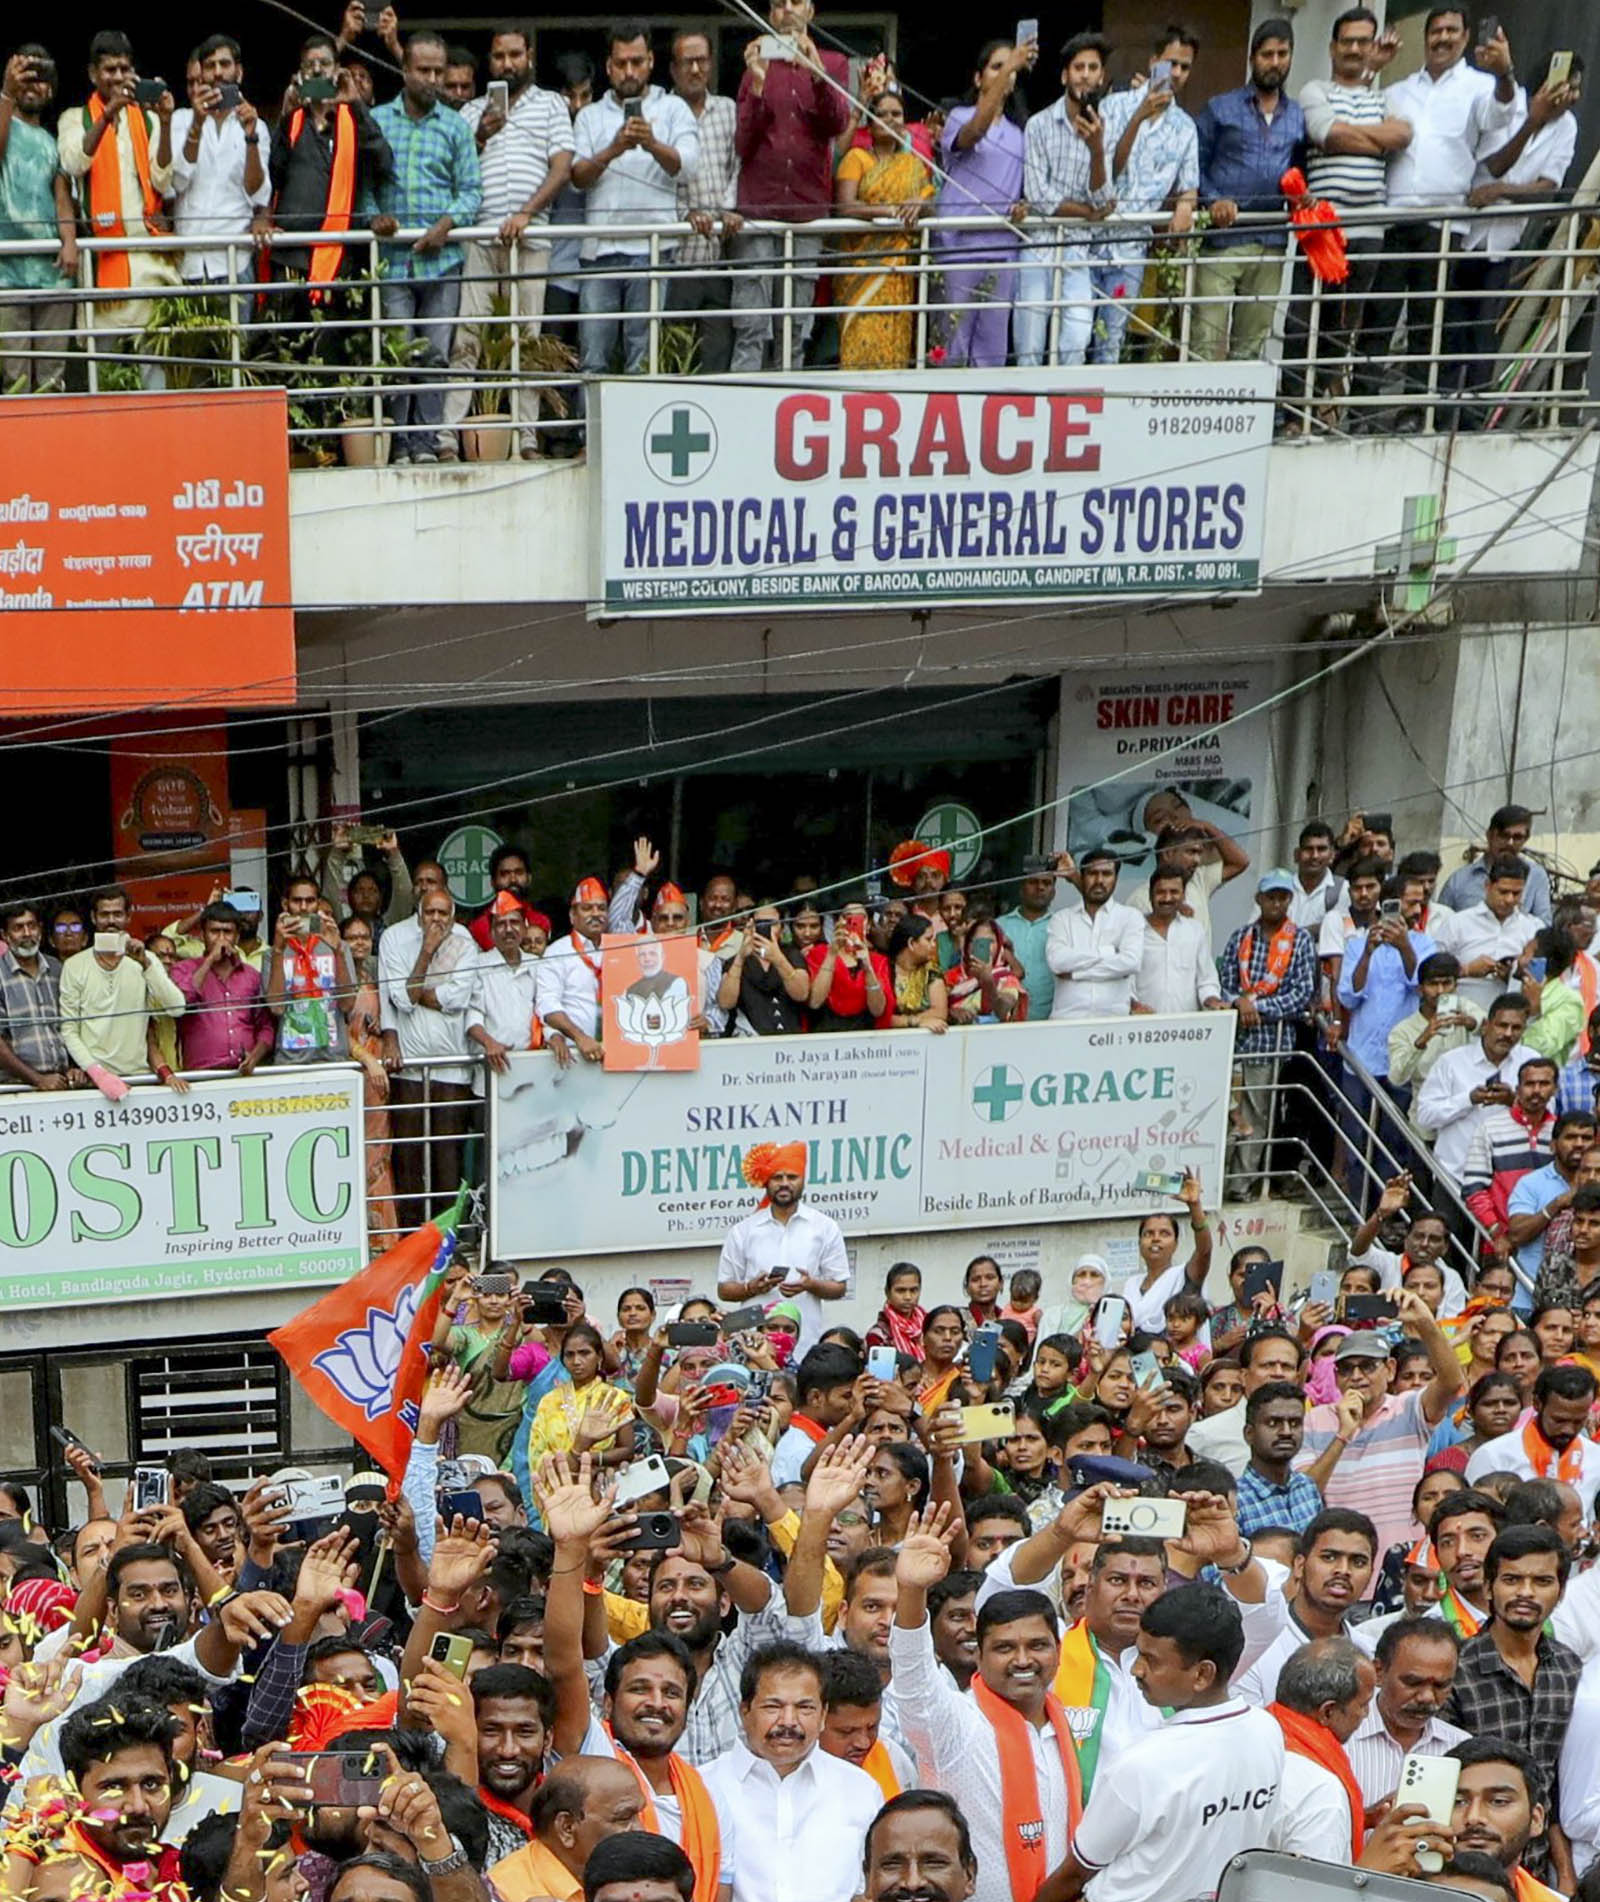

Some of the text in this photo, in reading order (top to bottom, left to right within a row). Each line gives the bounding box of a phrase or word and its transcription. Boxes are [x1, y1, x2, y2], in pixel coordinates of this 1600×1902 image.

[773, 386, 1105, 483] GRACE
[1147, 415, 1257, 436] 9182094087
[623, 483, 1247, 569] MEDICAL & GENERAL STORES
[176, 523, 264, 566] एटीएम
[178, 580, 265, 613] ATM
[622, 581, 689, 599] WESTEND
[690, 578, 749, 598] COLONY,
[751, 577, 800, 594] BESIDE
[802, 576, 841, 593] BANK
[843, 575, 861, 591] OF
[863, 573, 924, 592] BARODA,
[926, 565, 1033, 590] GANDHAMGUDA,
[1035, 564, 1100, 586] GANDIPET
[1126, 564, 1154, 583] R.R.
[1154, 563, 1186, 582] DIST.
[1195, 562, 1223, 581] 500
[1096, 693, 1236, 730] SKIN CARE
[1155, 767, 1224, 780] Dermatologist
[444, 859, 490, 876] GRAC
[1087, 1031, 1115, 1047] Cell
[1127, 1027, 1213, 1045] 9182094087
[774, 1050, 795, 1065] Dr.
[799, 1048, 830, 1066] Jaya
[834, 1044, 893, 1062] Lakshmi
[721, 1072, 742, 1087] Dr.
[745, 1068, 796, 1086] Srinath
[800, 1067, 858, 1084] Narayan
[1029, 1066, 1176, 1108] GRACE
[51, 1111, 87, 1130] +91
[94, 1102, 223, 1130] 8143903193,
[685, 1098, 848, 1134] SRIKANTH
[938, 1133, 1024, 1161] Medical
[1029, 1135, 1049, 1154] &
[1056, 1127, 1140, 1153] General
[620, 1132, 913, 1198] DENTA LINIC
[657, 1189, 879, 1213] Center For Dentistry
[924, 1181, 1098, 1213] Beside Bank of Baroda,
[164, 1229, 343, 1256] Inspiring Better Quality
[8, 1282, 57, 1299] Hotel,
[60, 1275, 150, 1297] Bandlaguda
[153, 1271, 195, 1292] Jagir,
[203, 1263, 284, 1285] Hyderabad
[299, 1256, 355, 1275] 500091
